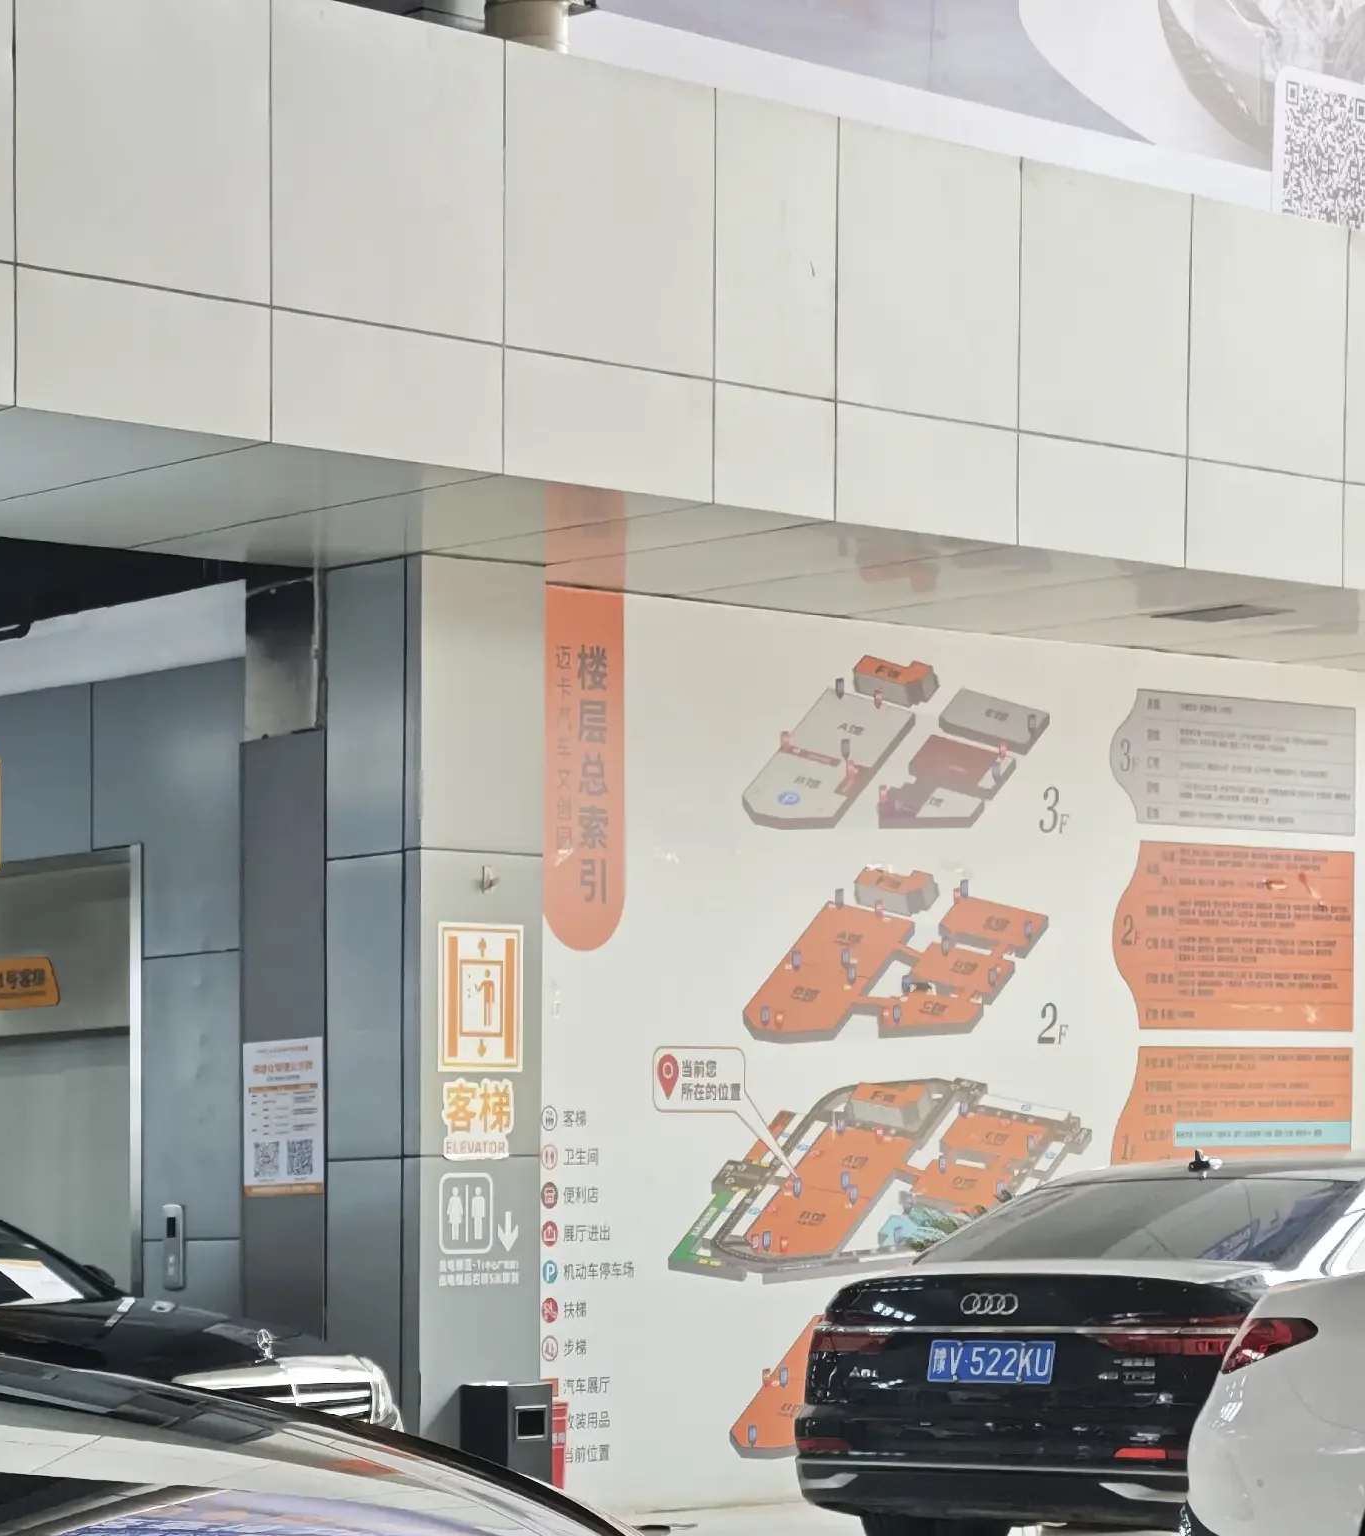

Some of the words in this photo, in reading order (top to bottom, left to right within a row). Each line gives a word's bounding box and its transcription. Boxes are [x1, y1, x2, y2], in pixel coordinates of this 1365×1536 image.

[577, 644, 609, 905] 楼层总索引
[1038, 786, 1070, 836] 3F
[1036, 1002, 1070, 1045] 2F
[680, 1059, 718, 1079] 当前您
[680, 1082, 742, 1102] 所在的位置
[445, 1082, 511, 1134] 客梯
[563, 1110, 587, 1128] 客梯
[445, 1139, 508, 1155] ELEVATOR
[563, 1148, 599, 1166] 卫生间
[563, 1186, 599, 1205] 便利店
[563, 1224, 611, 1243] 展厅进出
[563, 1262, 635, 1281] 机动车停车场
[563, 1302, 587, 1319] 扶梯
[563, 1339, 587, 1357] 步梯
[563, 1376, 611, 1395] 汽车展厅
